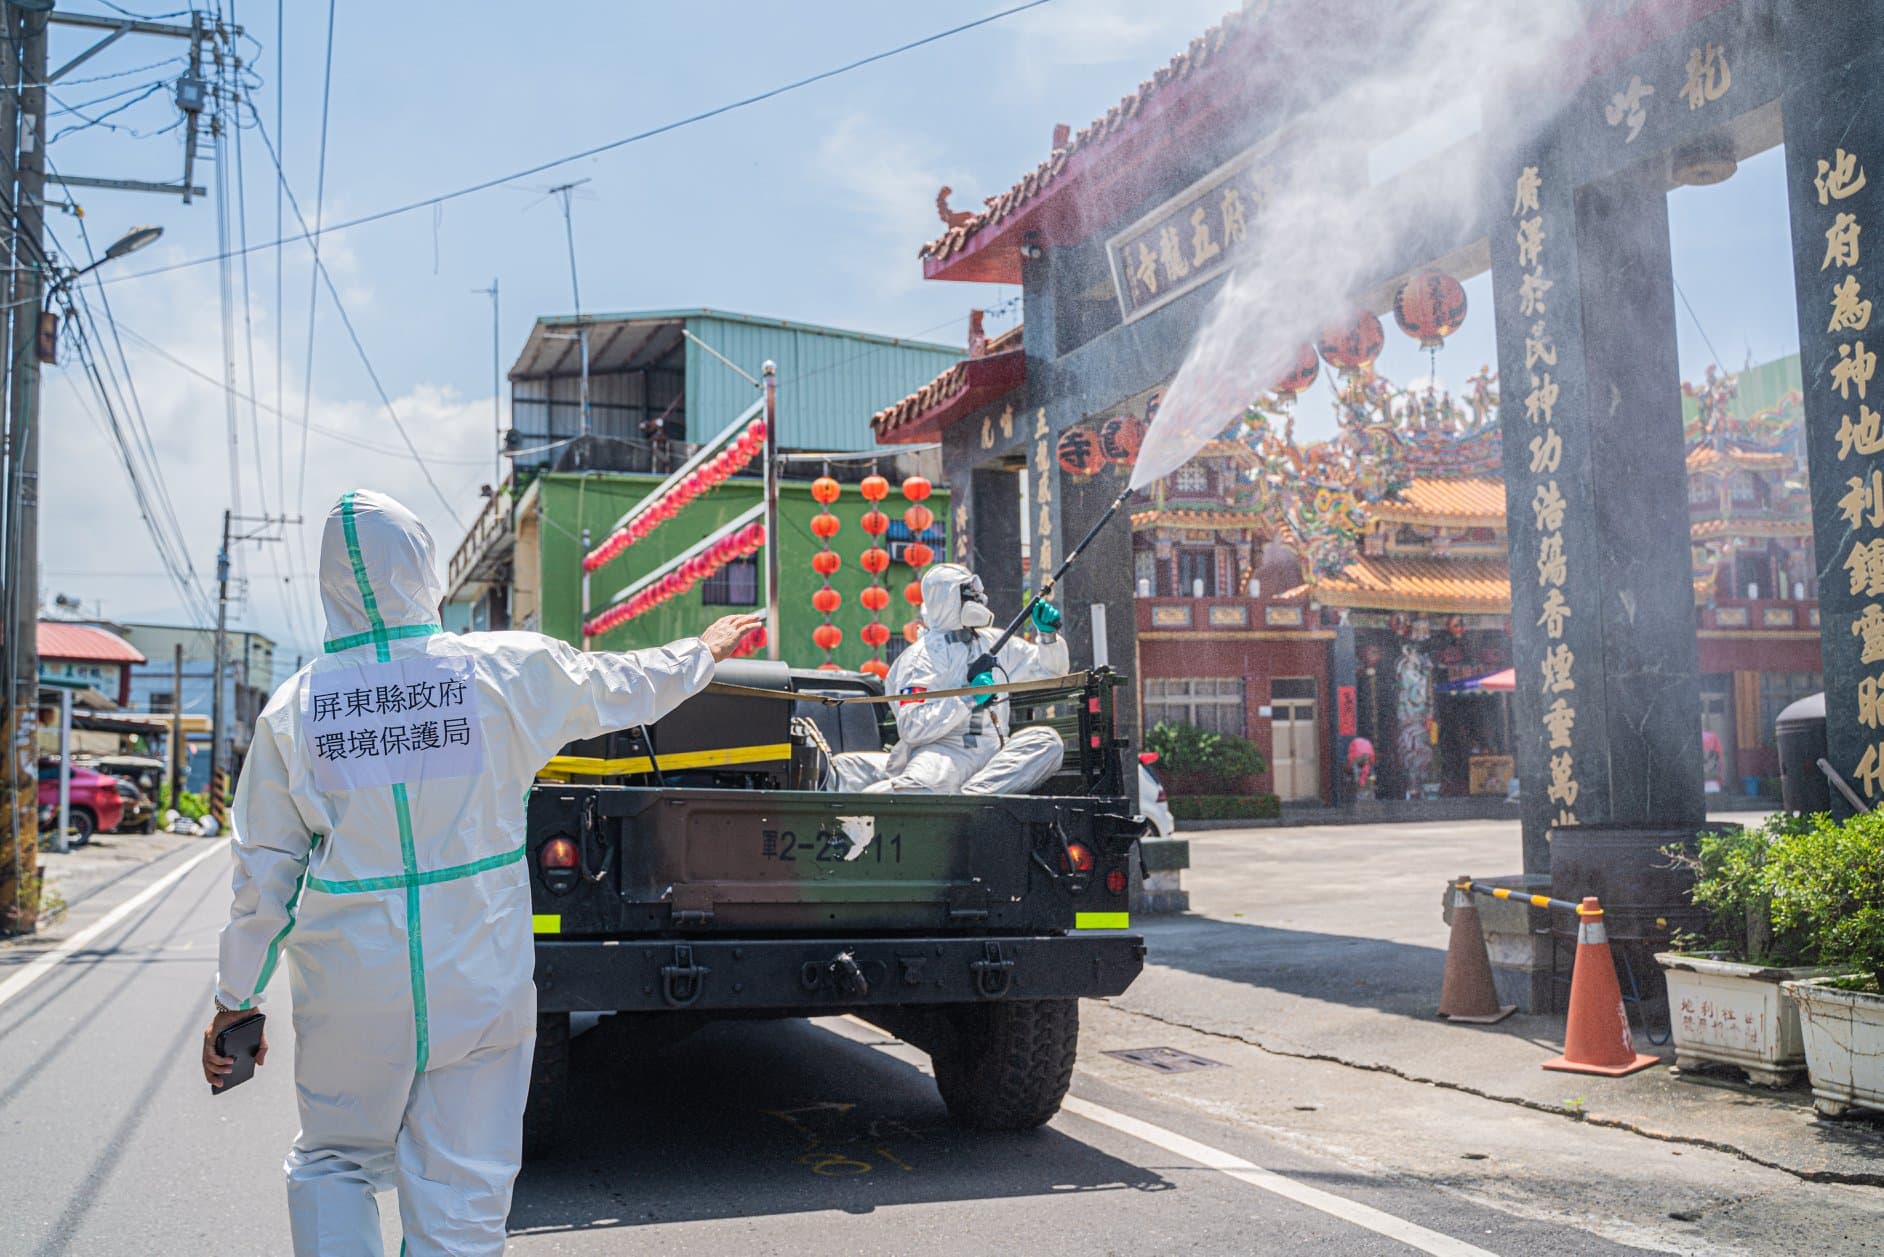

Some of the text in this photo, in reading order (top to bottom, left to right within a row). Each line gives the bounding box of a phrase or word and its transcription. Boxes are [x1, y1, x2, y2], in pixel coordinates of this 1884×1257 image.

[313, 678, 467, 722] 屏東縣政府
[315, 717, 470, 761] 環境保護局
[762, 830, 901, 863] 軍2-211
